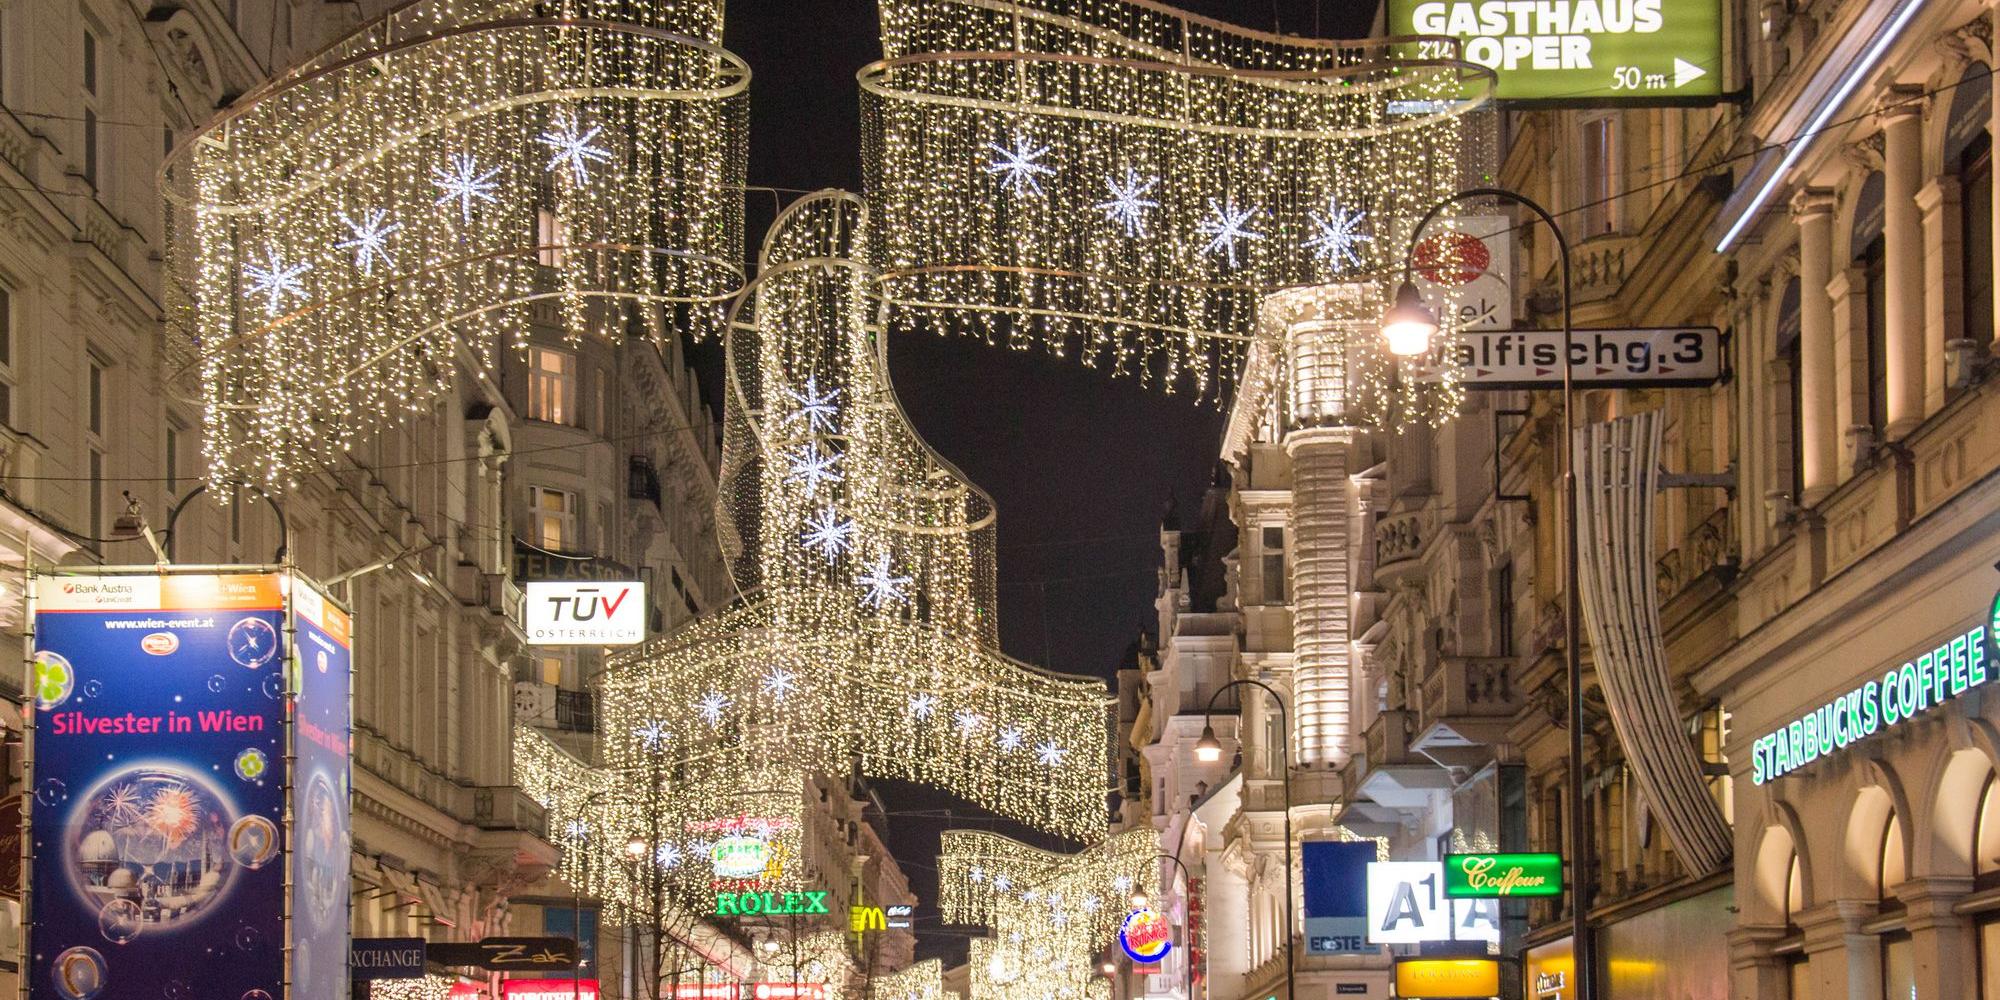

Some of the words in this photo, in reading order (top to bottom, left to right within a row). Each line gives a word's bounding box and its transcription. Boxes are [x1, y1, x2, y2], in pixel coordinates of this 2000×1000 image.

[1412, 0, 1663, 37] GASTHAUS
[1465, 34, 1593, 71] OPER
[1609, 65, 1641, 91] 50
[1645, 72, 1668, 91] m
[75, 583, 98, 594] Bank
[101, 583, 133, 594] Austria
[104, 617, 215, 629] www.wien-event.at
[1752, 680, 1880, 786] STARBUCKS
[1881, 625, 1987, 726] COFFEE
[52, 711, 161, 735] Silvester
[168, 711, 191, 733] in
[198, 709, 264, 732] Wien
[1462, 856, 1546, 896] Coiffeur
[716, 890, 829, 916] ROLEX
[1381, 872, 1437, 932] A1
[481, 944, 572, 964] Zak
